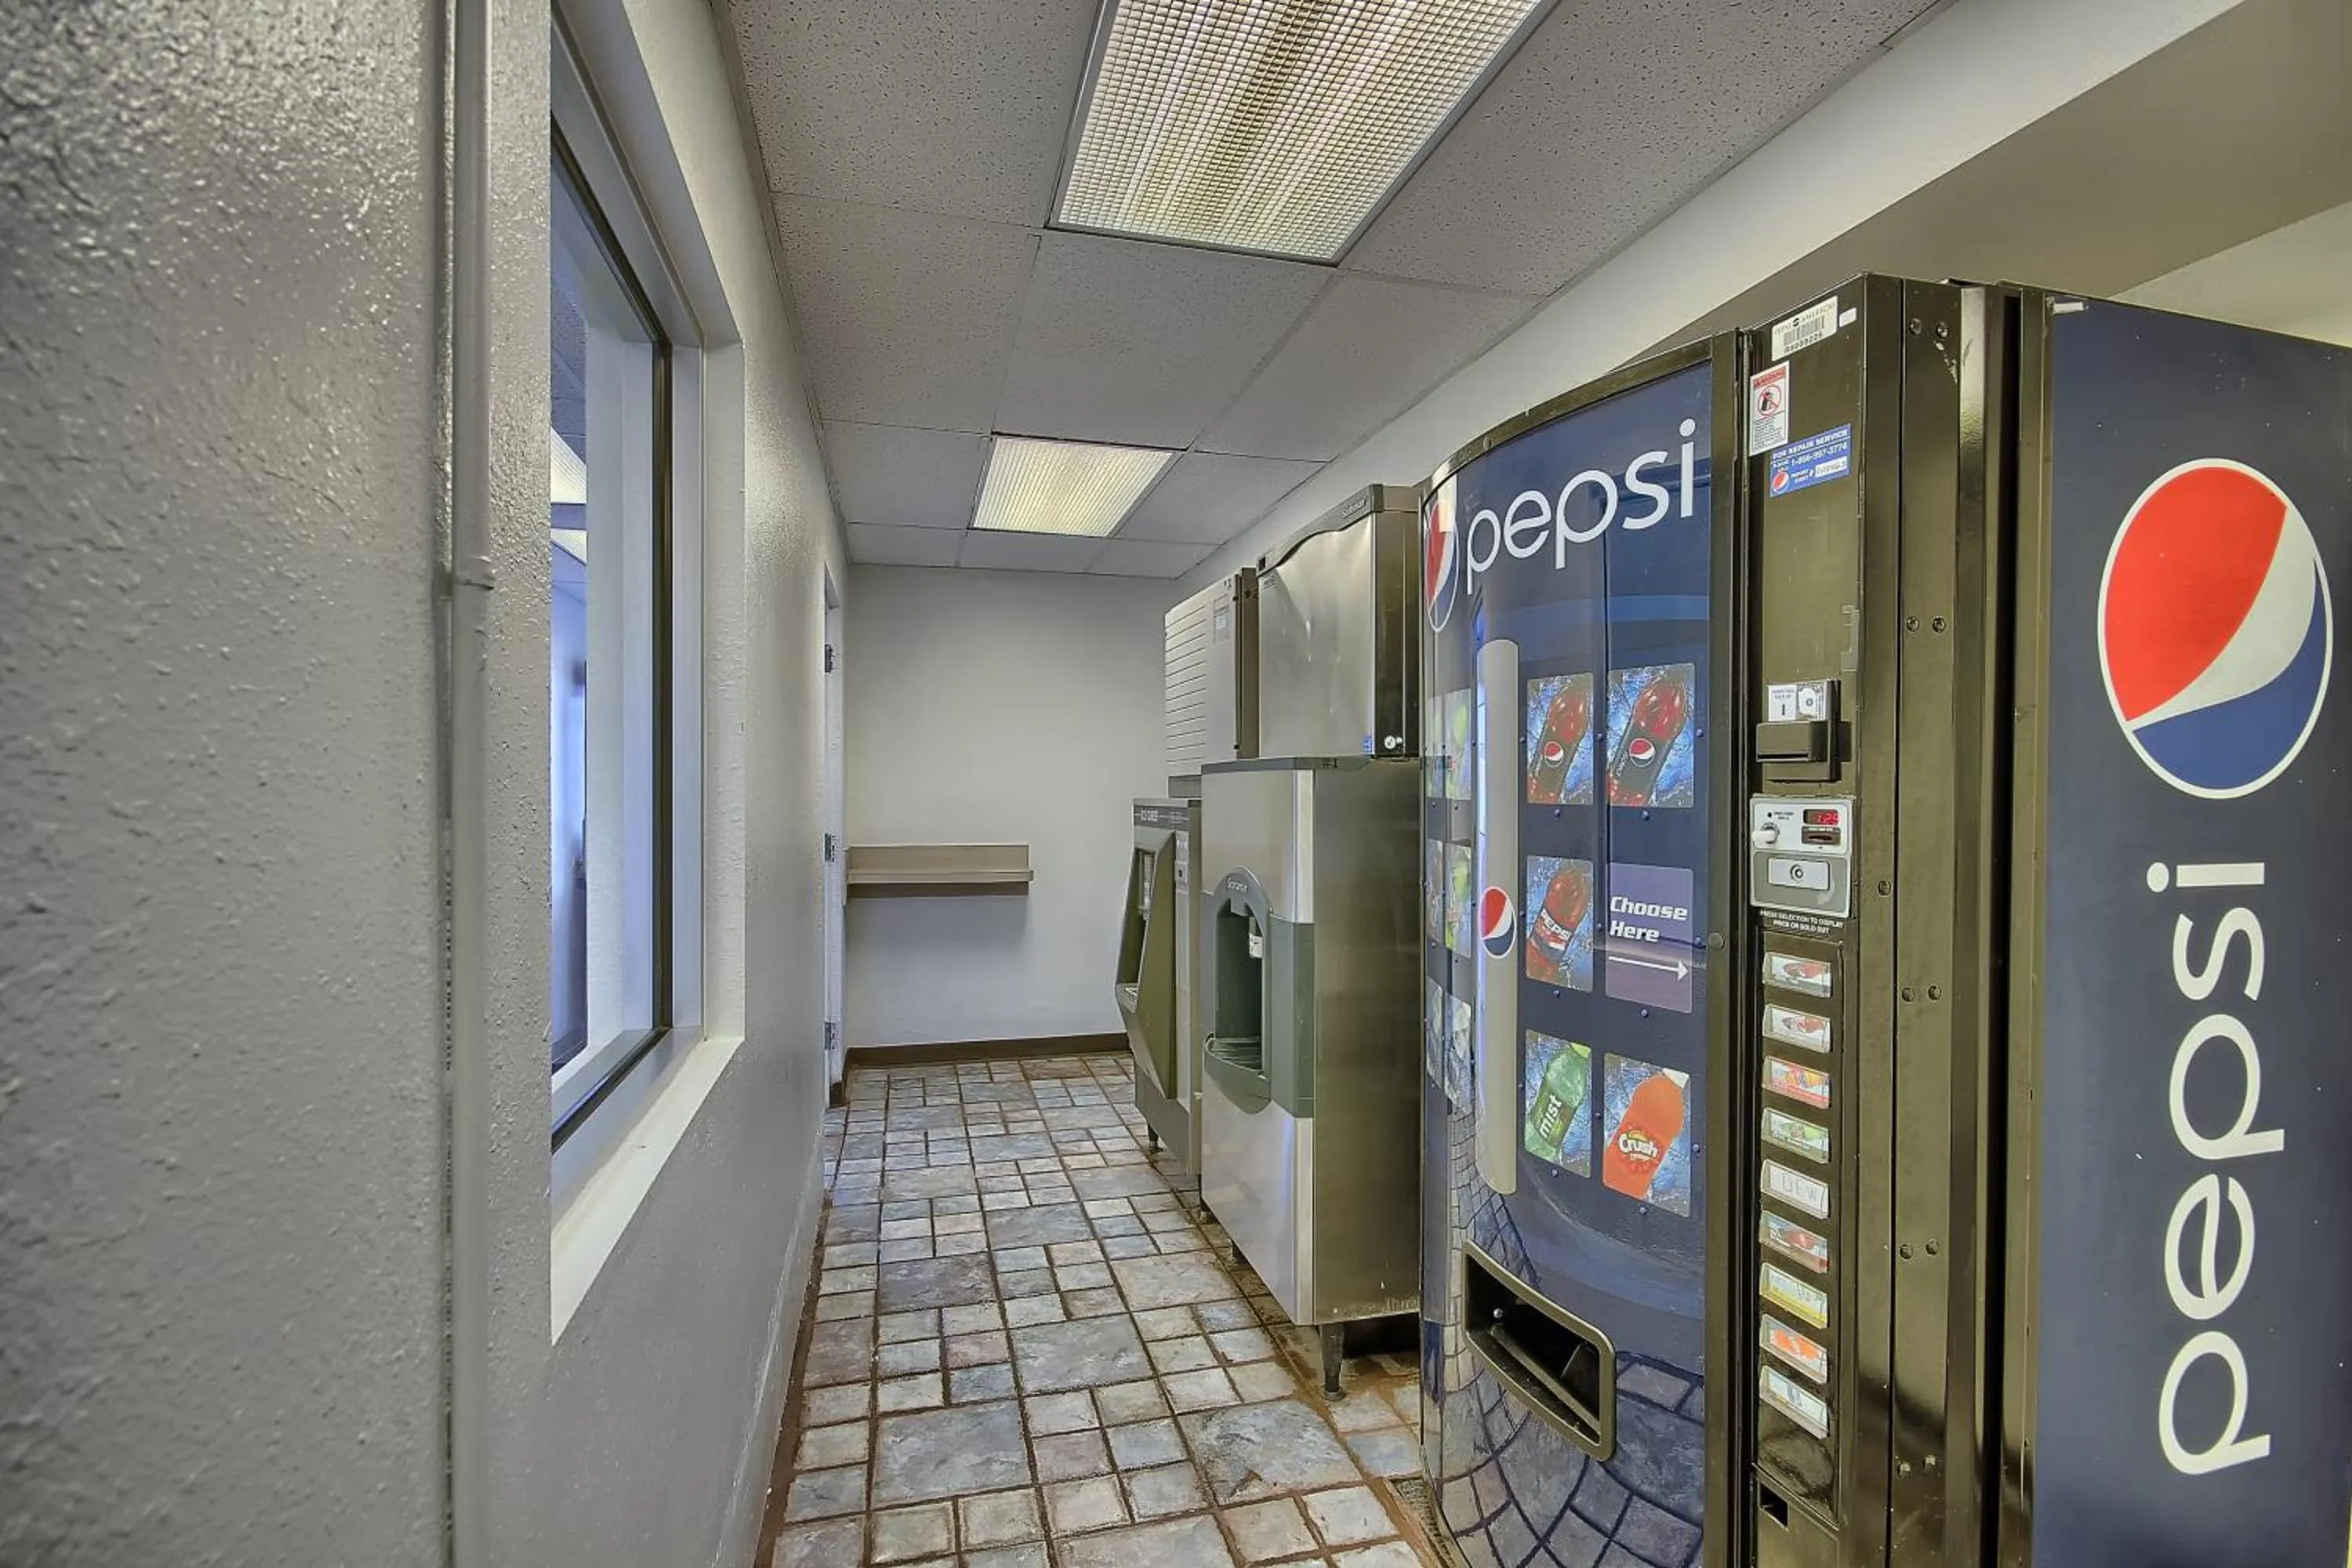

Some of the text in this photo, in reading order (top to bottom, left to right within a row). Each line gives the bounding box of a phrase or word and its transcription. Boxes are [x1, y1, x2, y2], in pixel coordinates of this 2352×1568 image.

[1467, 418, 1696, 595] pepsi
[1610, 895, 1688, 921] Choose
[1610, 920, 1660, 942] Here
[1799, 924, 1817, 932] SOLD
[1539, 1094, 1562, 1138] mist
[1618, 1132, 1658, 1158] Crush
[2147, 861, 2285, 1475] pepsi
